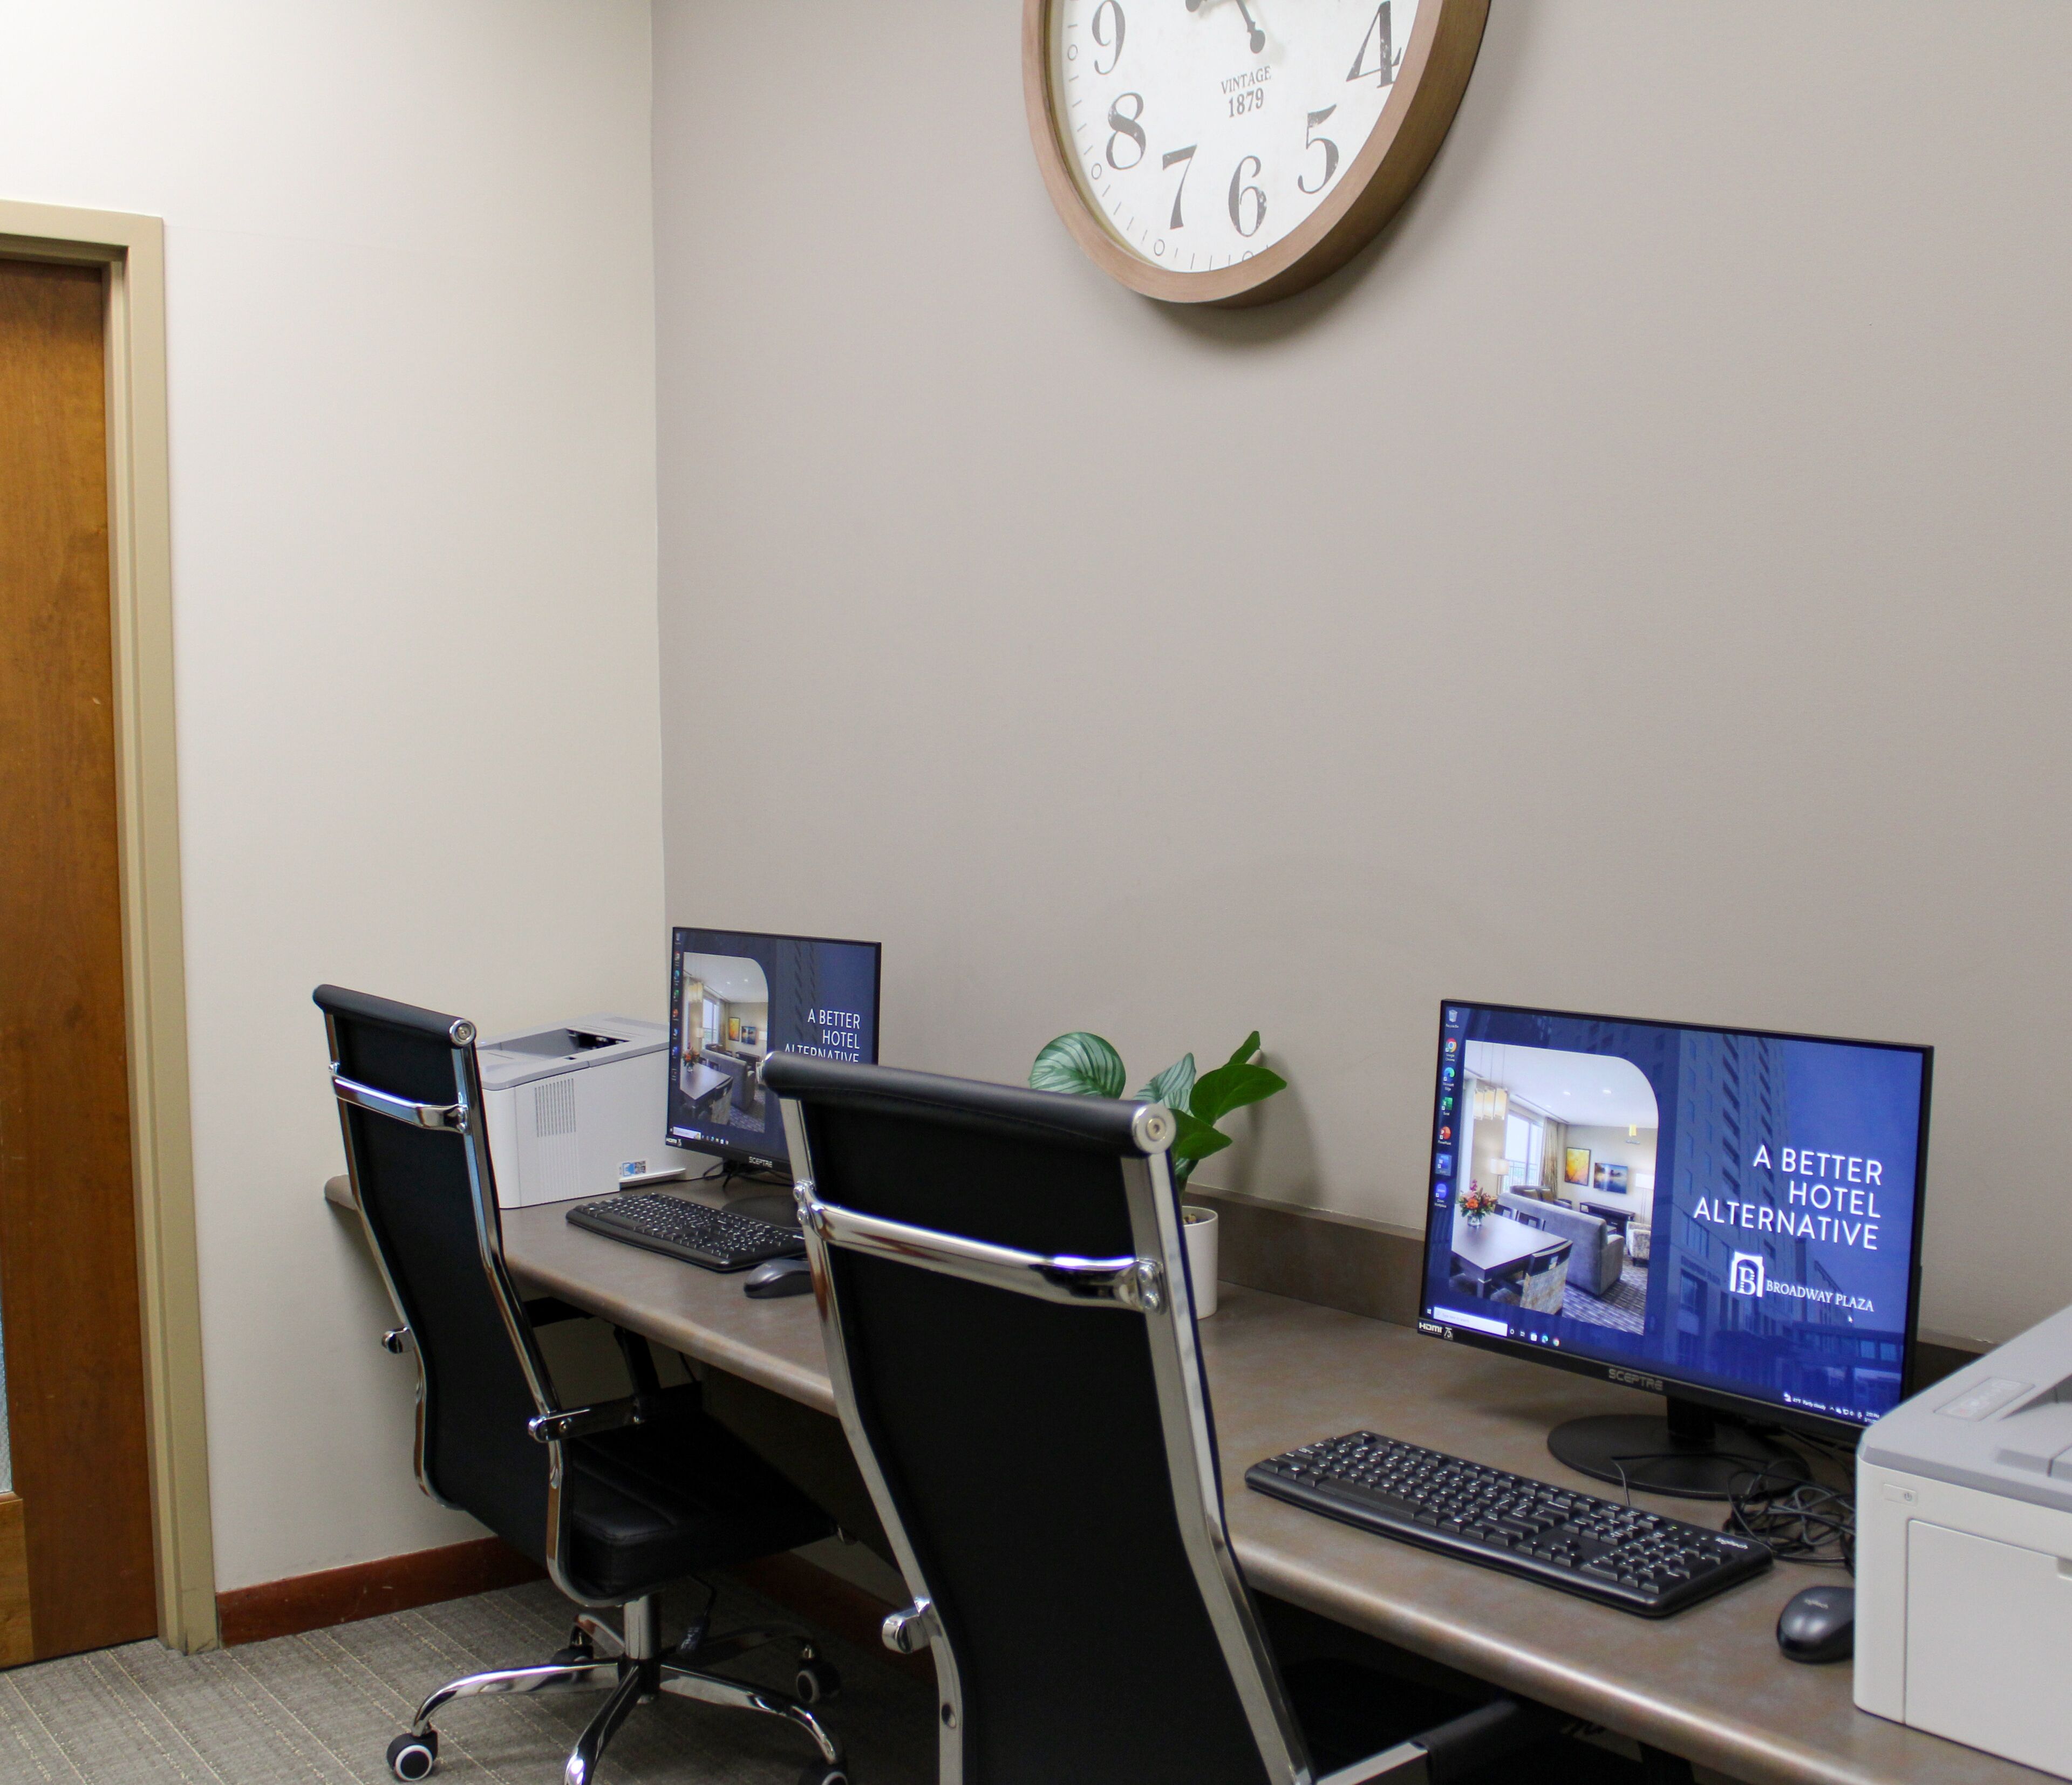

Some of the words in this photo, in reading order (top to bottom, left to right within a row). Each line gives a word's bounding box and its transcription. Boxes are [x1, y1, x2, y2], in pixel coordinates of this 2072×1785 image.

[1092, 0, 1126, 76] 9
[1346, 0, 1402, 89] 4
[1221, 65, 1272, 94] VINTAGE
[1228, 87, 1264, 118] 1879
[1106, 92, 1147, 170] 8
[1297, 104, 1339, 194] 5
[1162, 144, 1198, 230] 7
[1228, 155, 1267, 238] 6
[807, 1008, 816, 1024] A
[819, 1009, 861, 1030] BETTER
[822, 1029, 860, 1049] HOTEL
[748, 1156, 773, 1168] SCEPTRE
[1753, 1144, 1771, 1170] A
[1782, 1147, 1883, 1186] BETTER
[1789, 1180, 1882, 1218] HOTEL
[1693, 1196, 1879, 1250] ALTERNATIVE
[1766, 1280, 1834, 1304] BROADWAY
[1836, 1292, 1875, 1312] PLAZA
[1608, 1369, 1664, 1391] SCEPTRE
